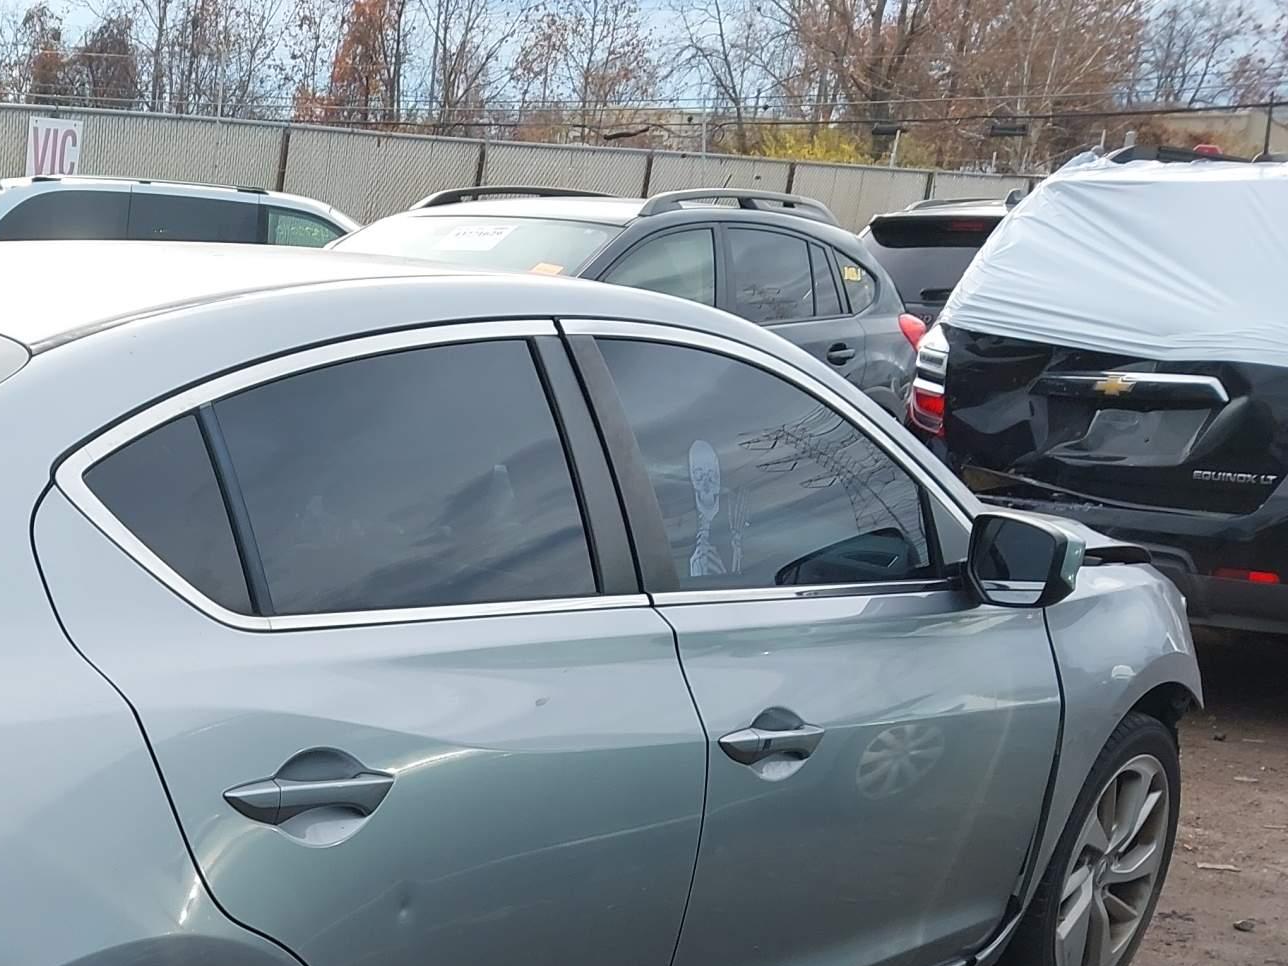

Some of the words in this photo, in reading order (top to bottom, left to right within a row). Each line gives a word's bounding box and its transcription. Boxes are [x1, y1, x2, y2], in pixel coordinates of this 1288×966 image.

[32, 126, 78, 176] VIC
[1192, 470, 1258, 483] EQUINOX
[1260, 475, 1278, 485] LT
